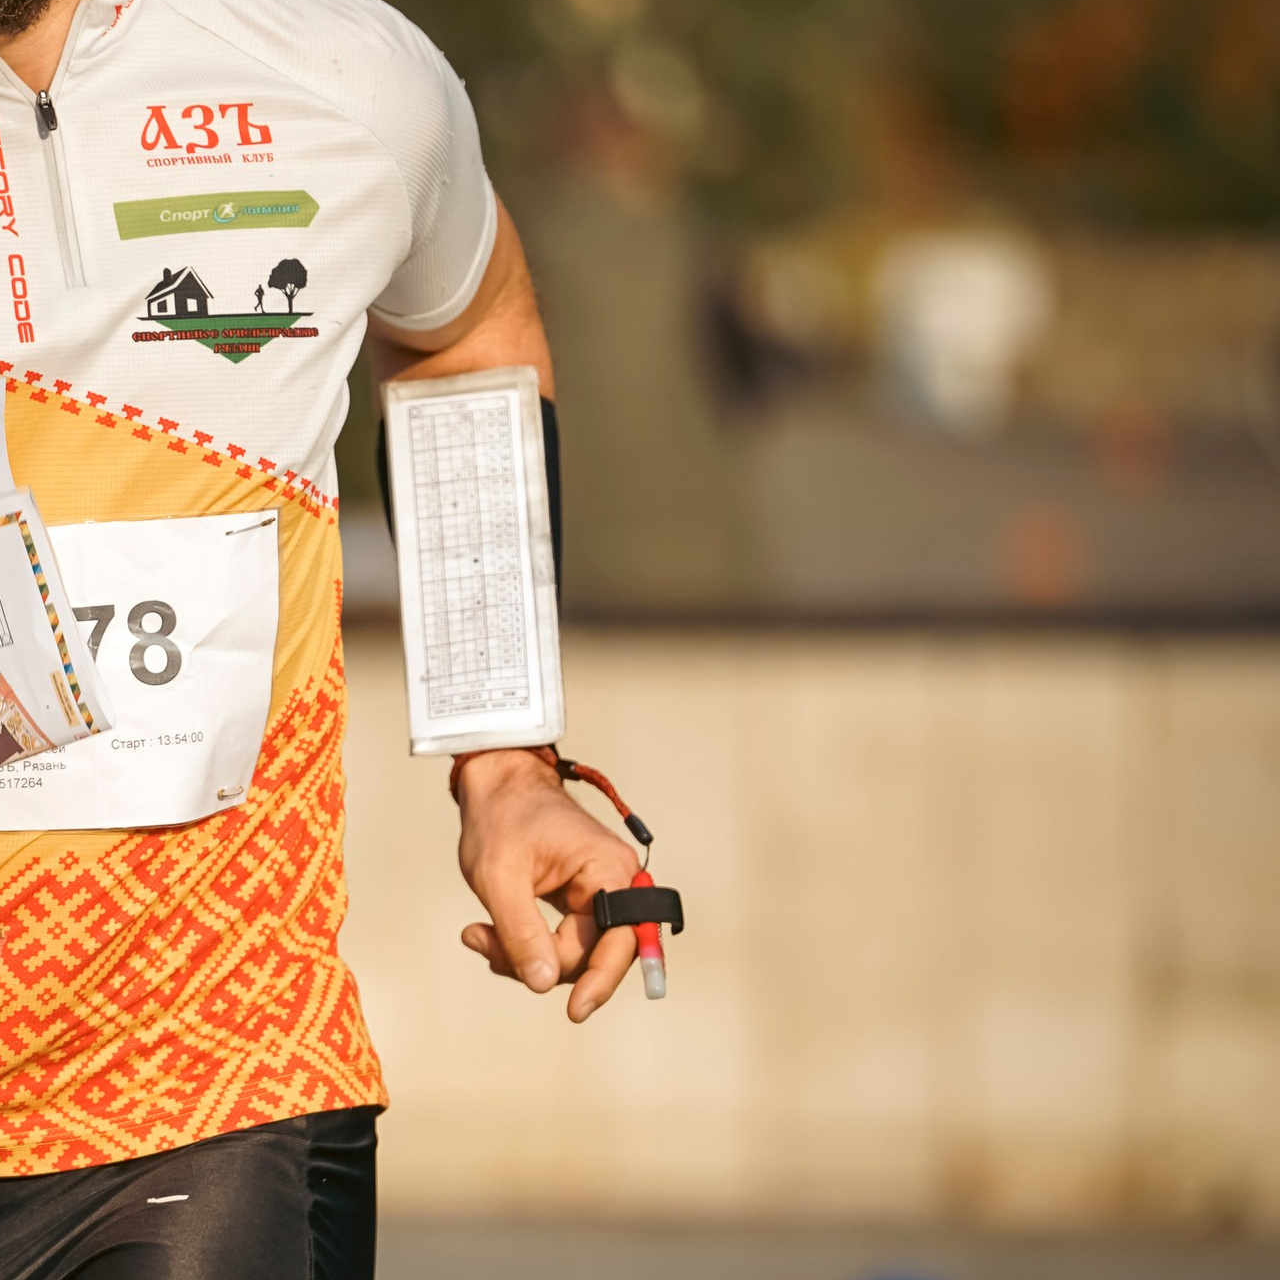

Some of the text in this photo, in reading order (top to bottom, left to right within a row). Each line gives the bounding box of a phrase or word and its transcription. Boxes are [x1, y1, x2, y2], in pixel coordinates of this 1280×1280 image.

[141, 103, 273, 154] АЗЪ
[146, 152, 274, 168] СПОРТИВНЫЙ КЛУБ
[159, 208, 212, 224] Спорт
[8, 254, 35, 343] CODE
[111, 738, 147, 750] Старт
[157, 731, 204, 746] 13:54:00
[23, 760, 67, 772] Рязань
